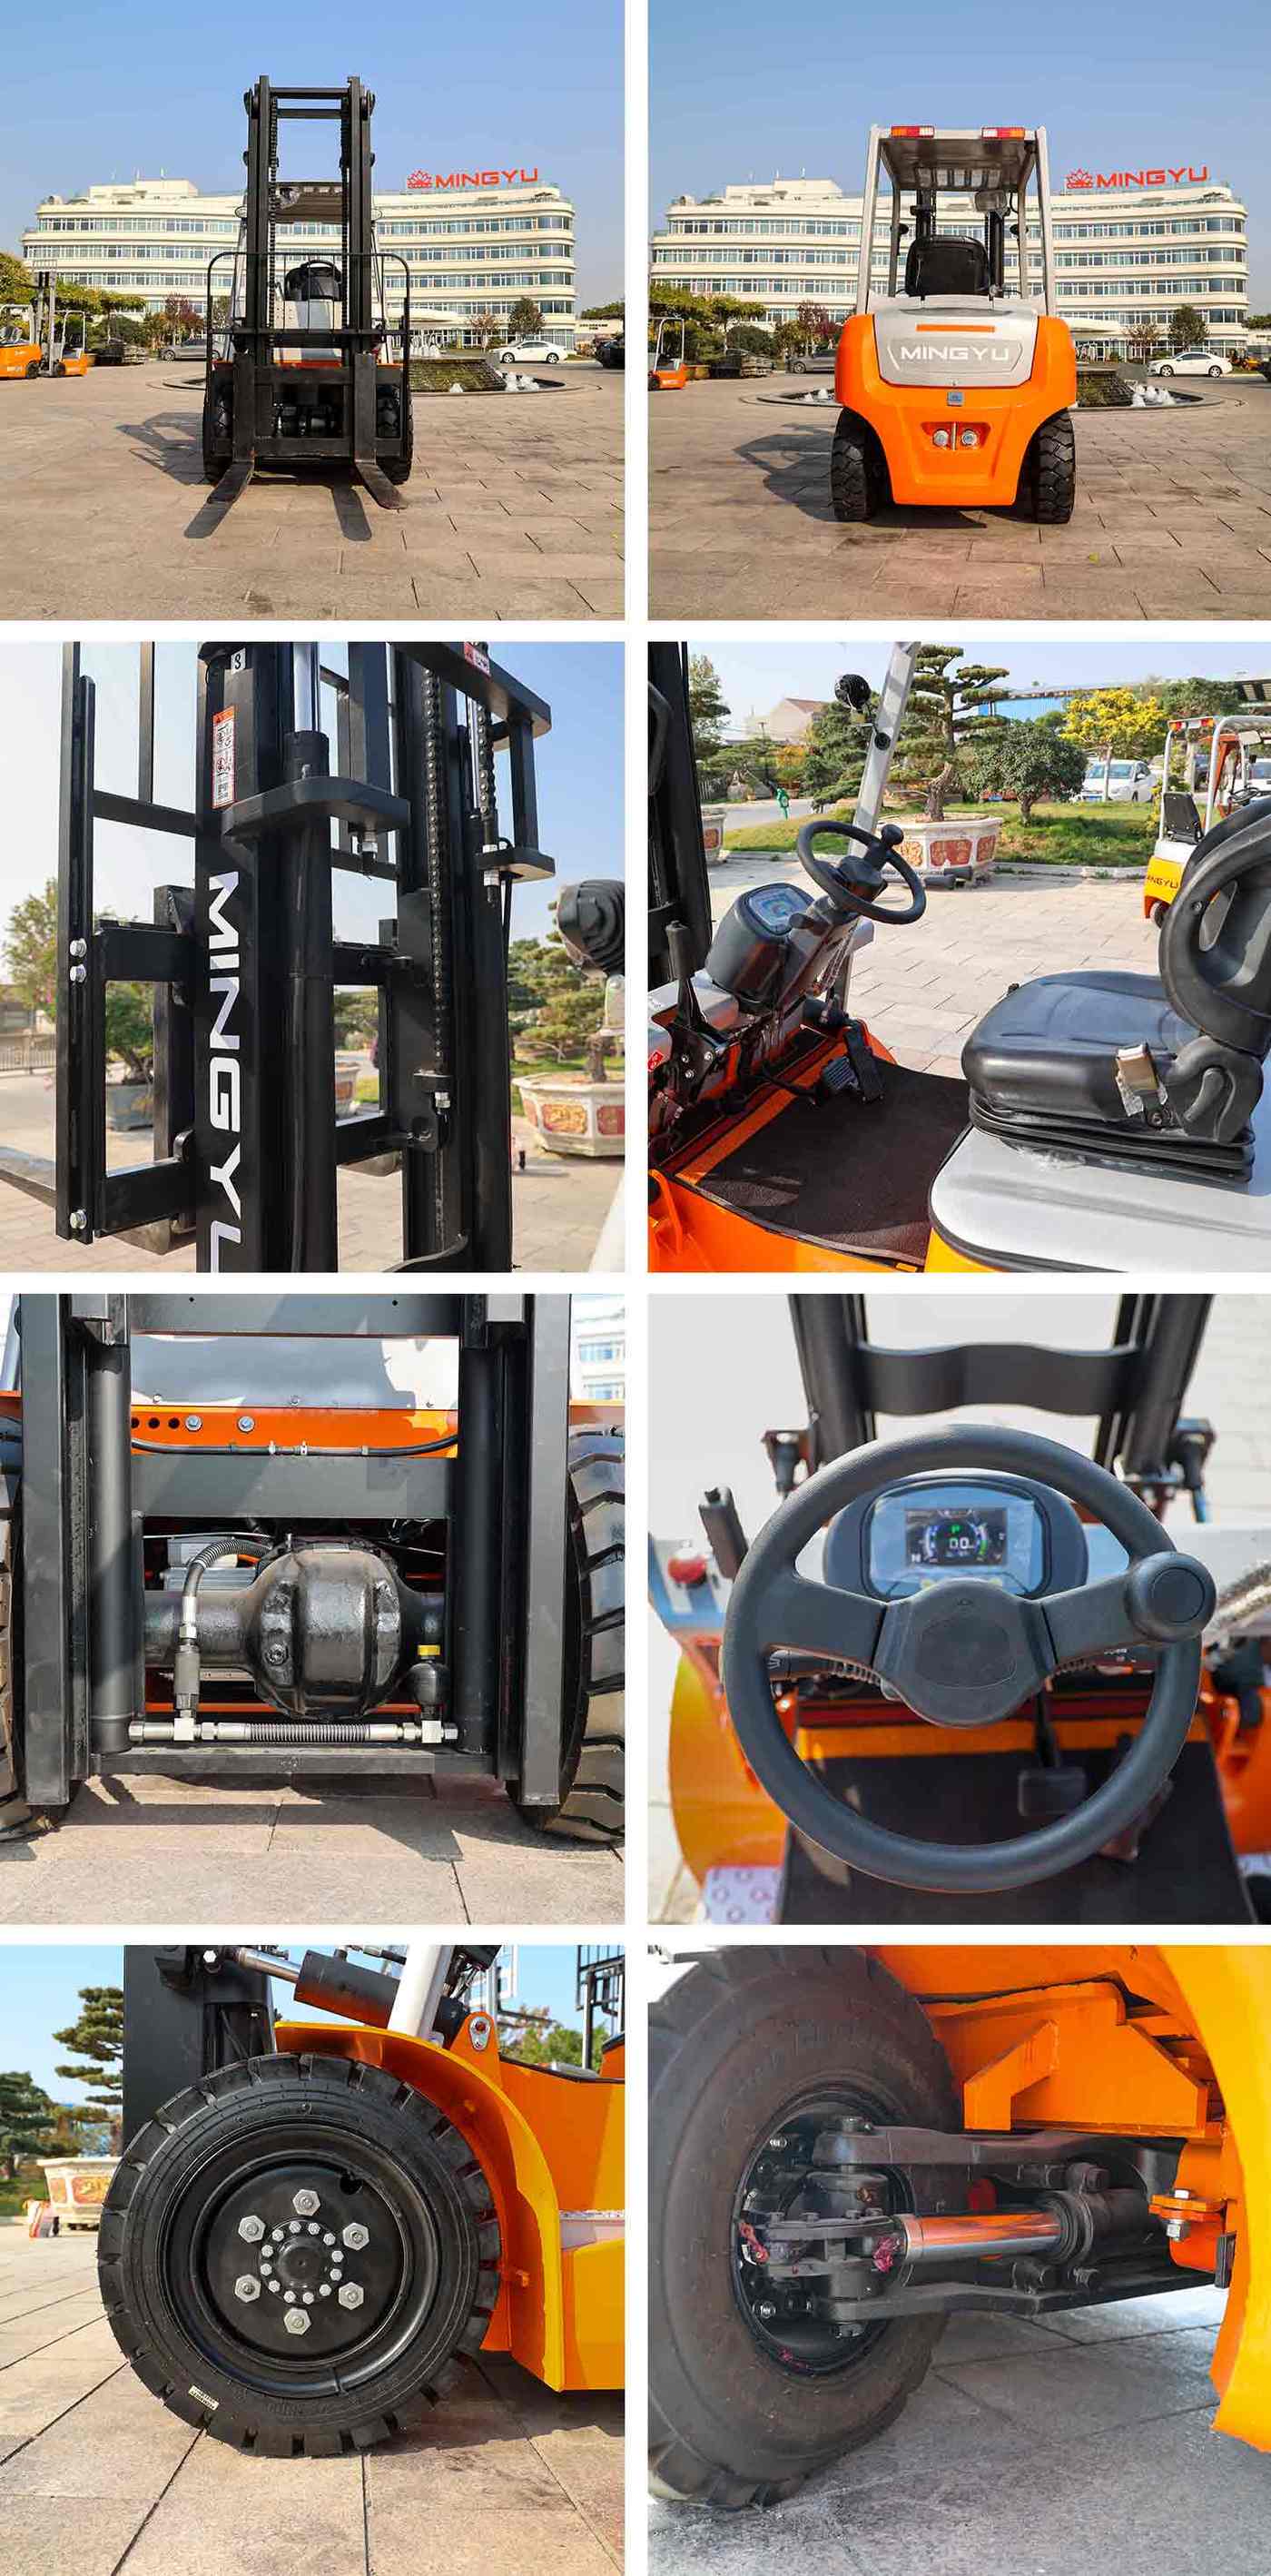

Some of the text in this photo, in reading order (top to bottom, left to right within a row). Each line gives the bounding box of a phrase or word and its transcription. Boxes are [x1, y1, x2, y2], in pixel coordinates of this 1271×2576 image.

[436, 167, 538, 189] MINGYU
[1096, 166, 1207, 188] MINGYU
[901, 345, 1010, 361] MINGYU
